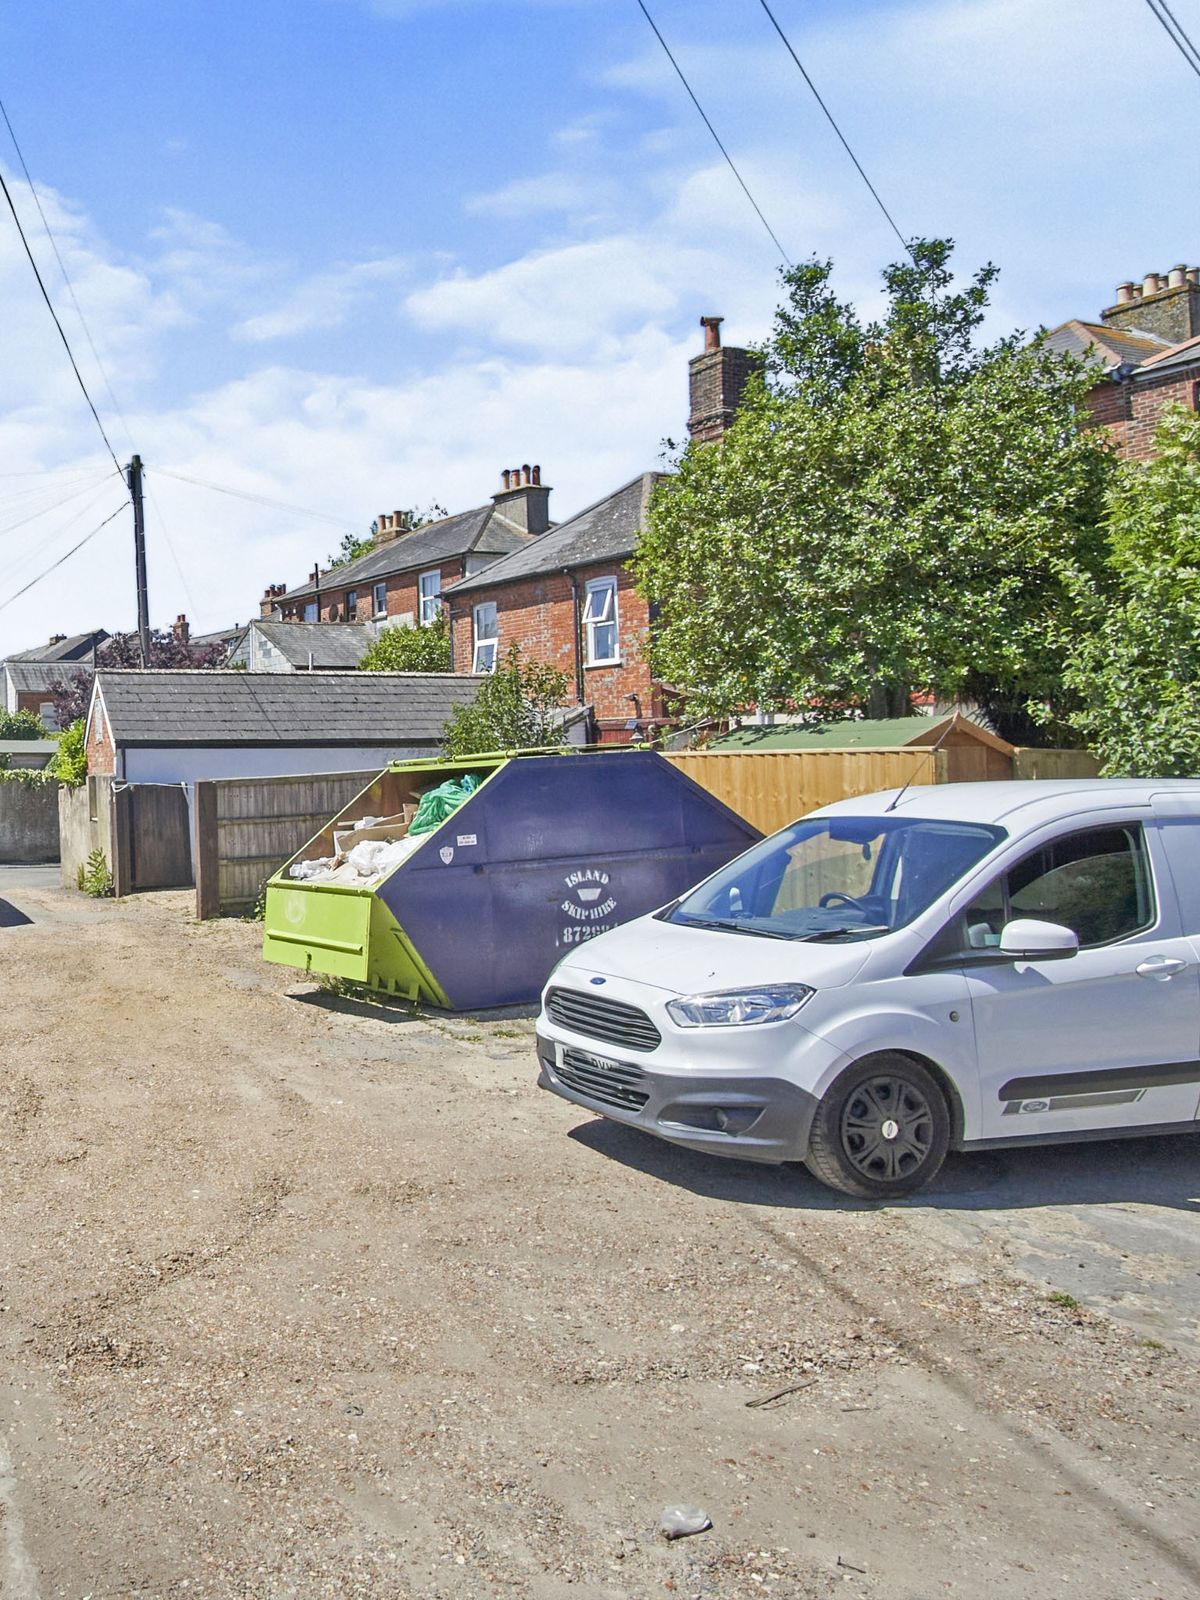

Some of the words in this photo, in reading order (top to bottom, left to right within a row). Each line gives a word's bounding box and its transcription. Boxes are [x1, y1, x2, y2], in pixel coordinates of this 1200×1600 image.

[564, 869, 609, 888] ISLAND
[561, 900, 589, 920] SKIP
[590, 897, 617, 919] HIRE
